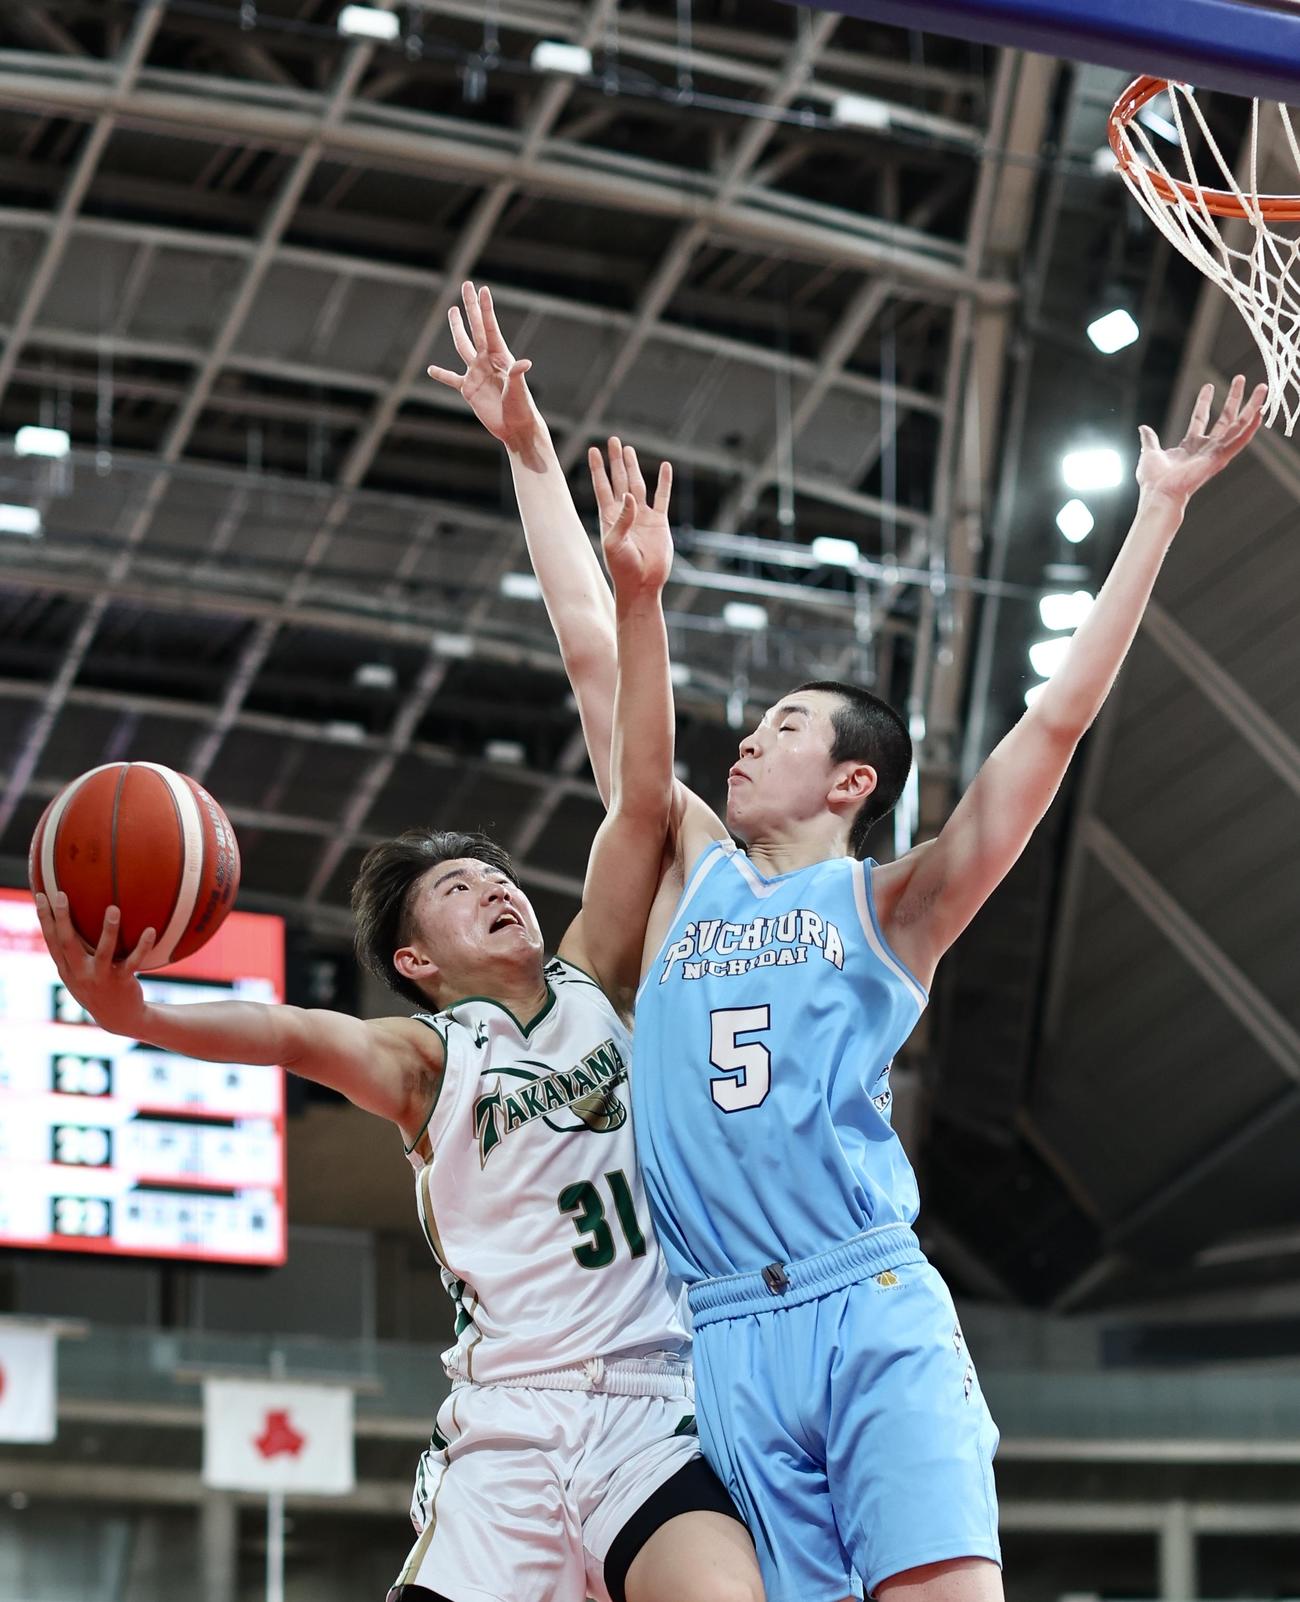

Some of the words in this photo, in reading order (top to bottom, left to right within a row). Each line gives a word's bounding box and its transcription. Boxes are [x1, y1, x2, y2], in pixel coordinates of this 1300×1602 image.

[682, 946, 808, 980] NICHIDAI
[472, 1038, 627, 1171] TAKAYAMA
[709, 1003, 772, 1114] 5
[557, 1168, 647, 1270] 31
